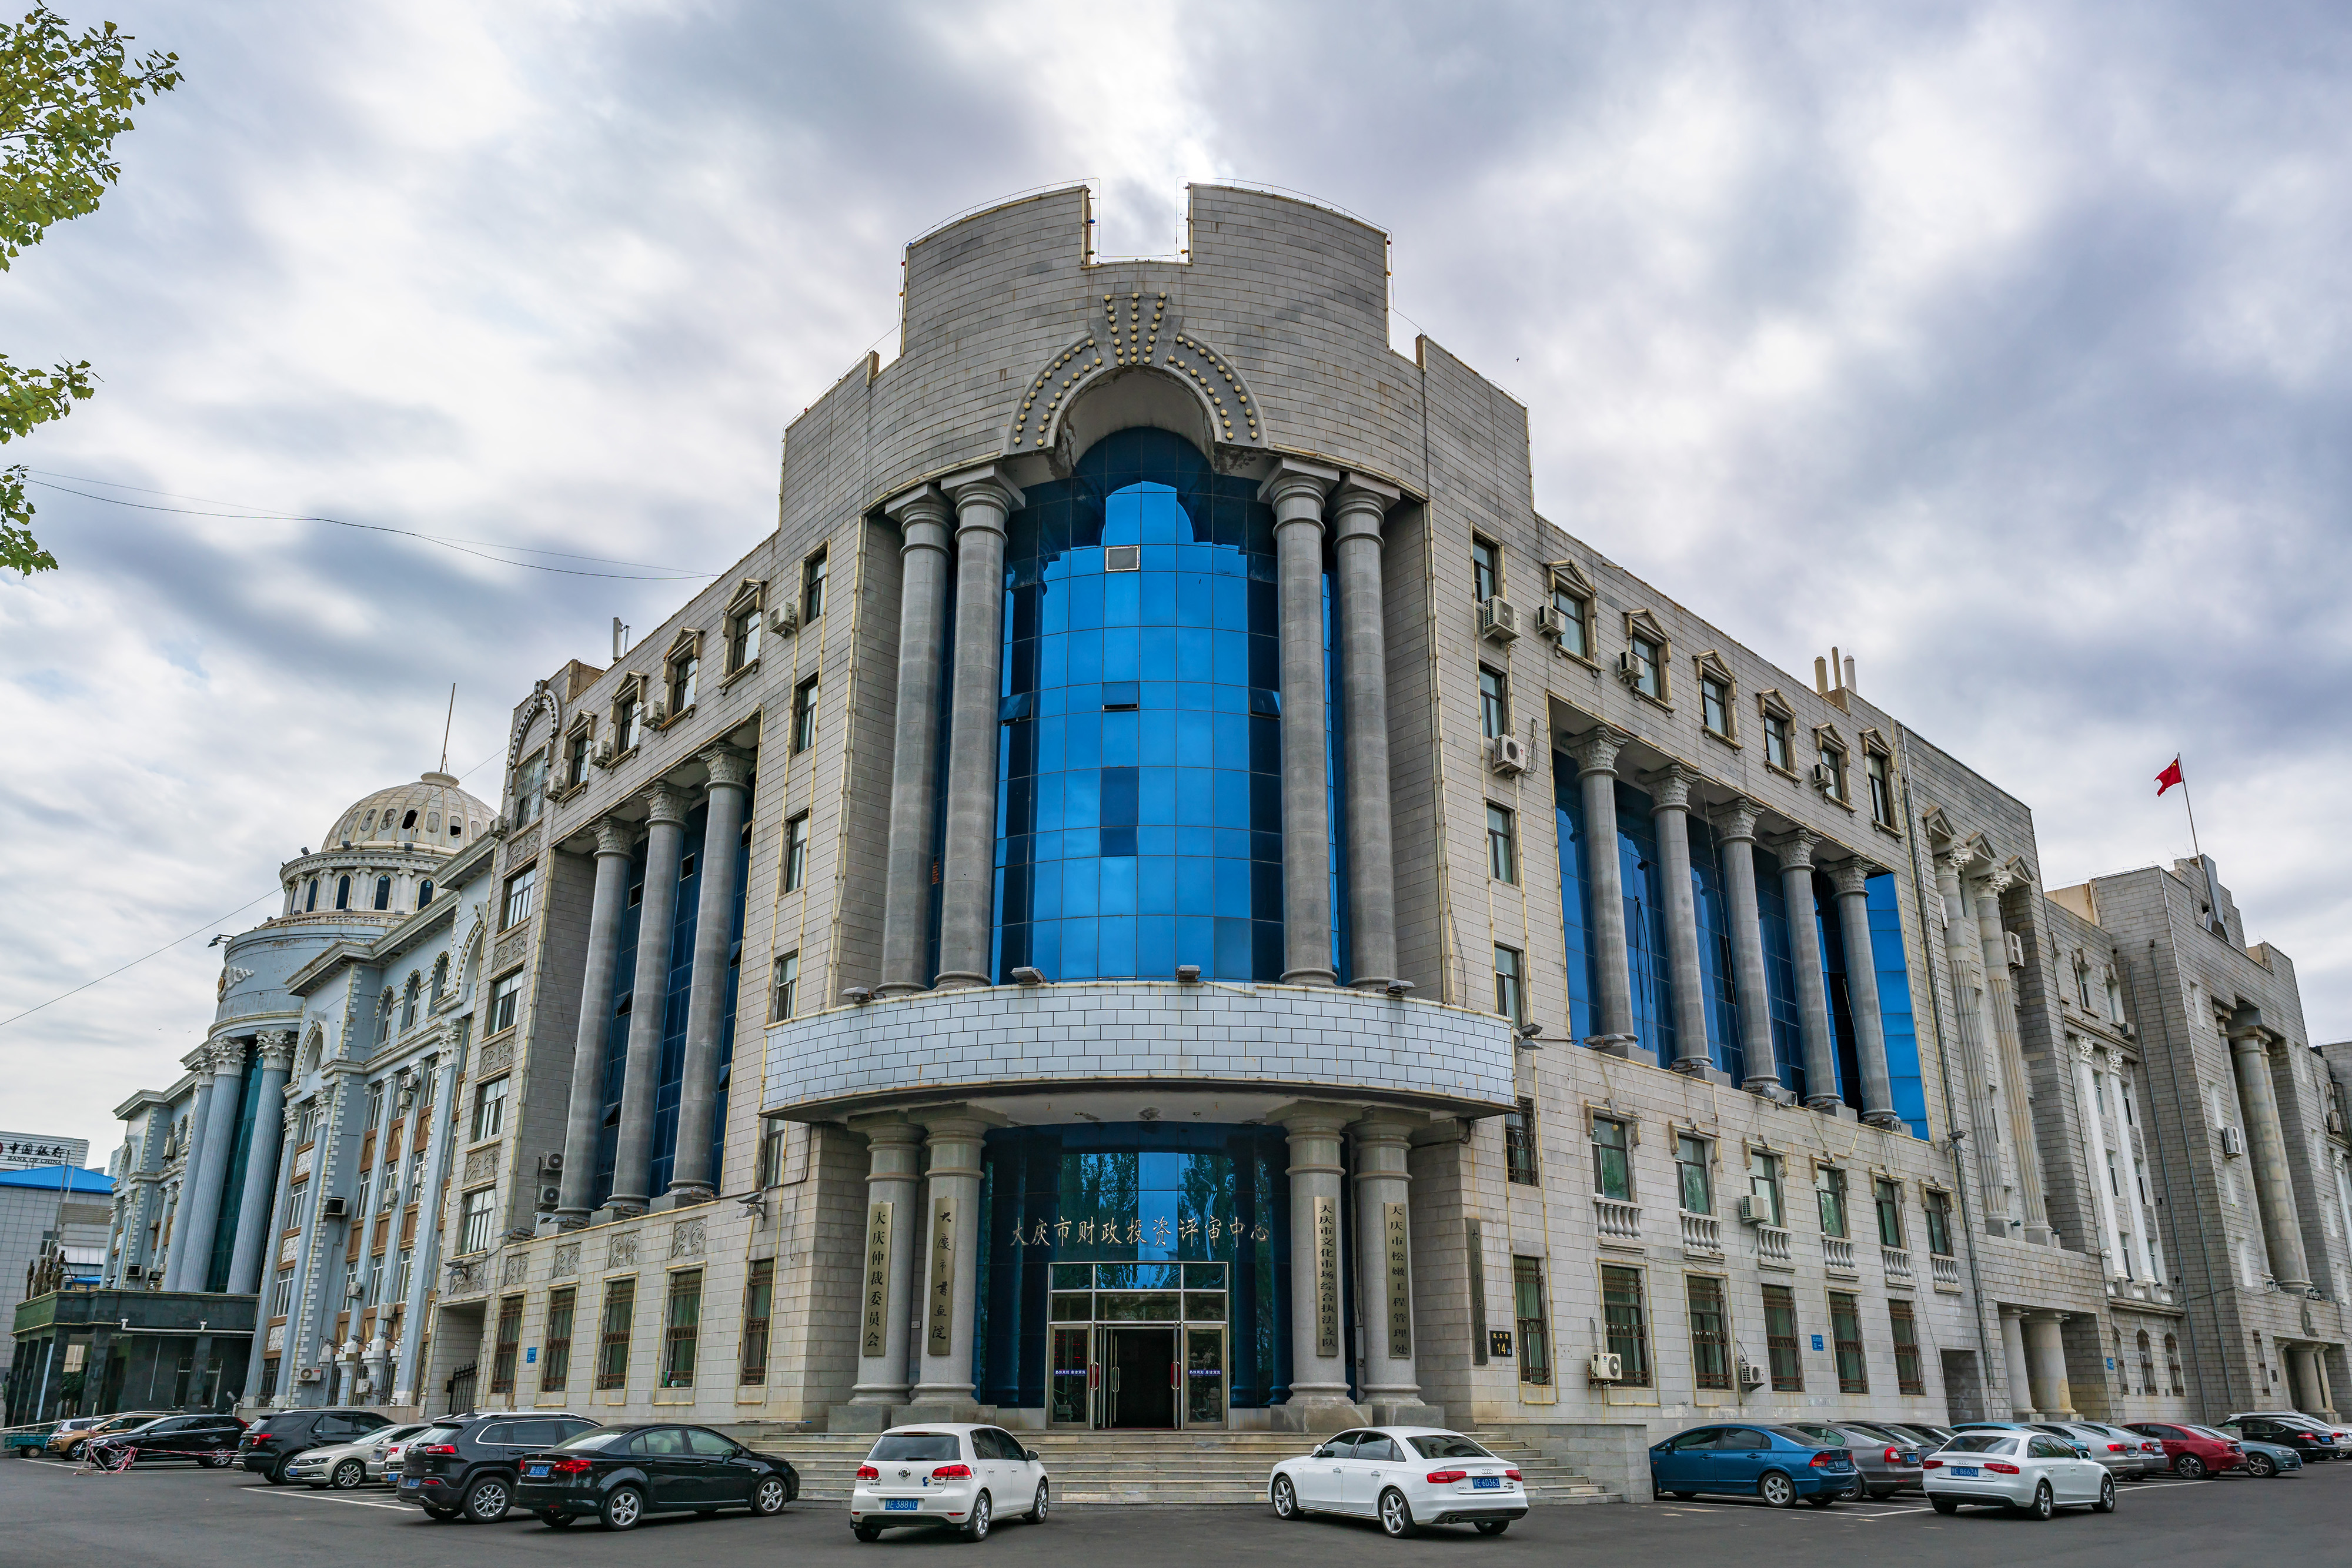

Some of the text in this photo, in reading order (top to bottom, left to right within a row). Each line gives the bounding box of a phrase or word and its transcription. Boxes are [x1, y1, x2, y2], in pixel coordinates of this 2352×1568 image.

[867, 1211, 886, 1347] 大庆仲裁委员会
[1010, 1215, 1269, 1247] 大庆市财政投资评审中心
[1319, 1205, 1335, 1347] 大庆市文化市场综合执法支队
[1390, 1206, 1408, 1354] 大庆市松嫩工程管理处
[1497, 1343, 1506, 1354] 14
